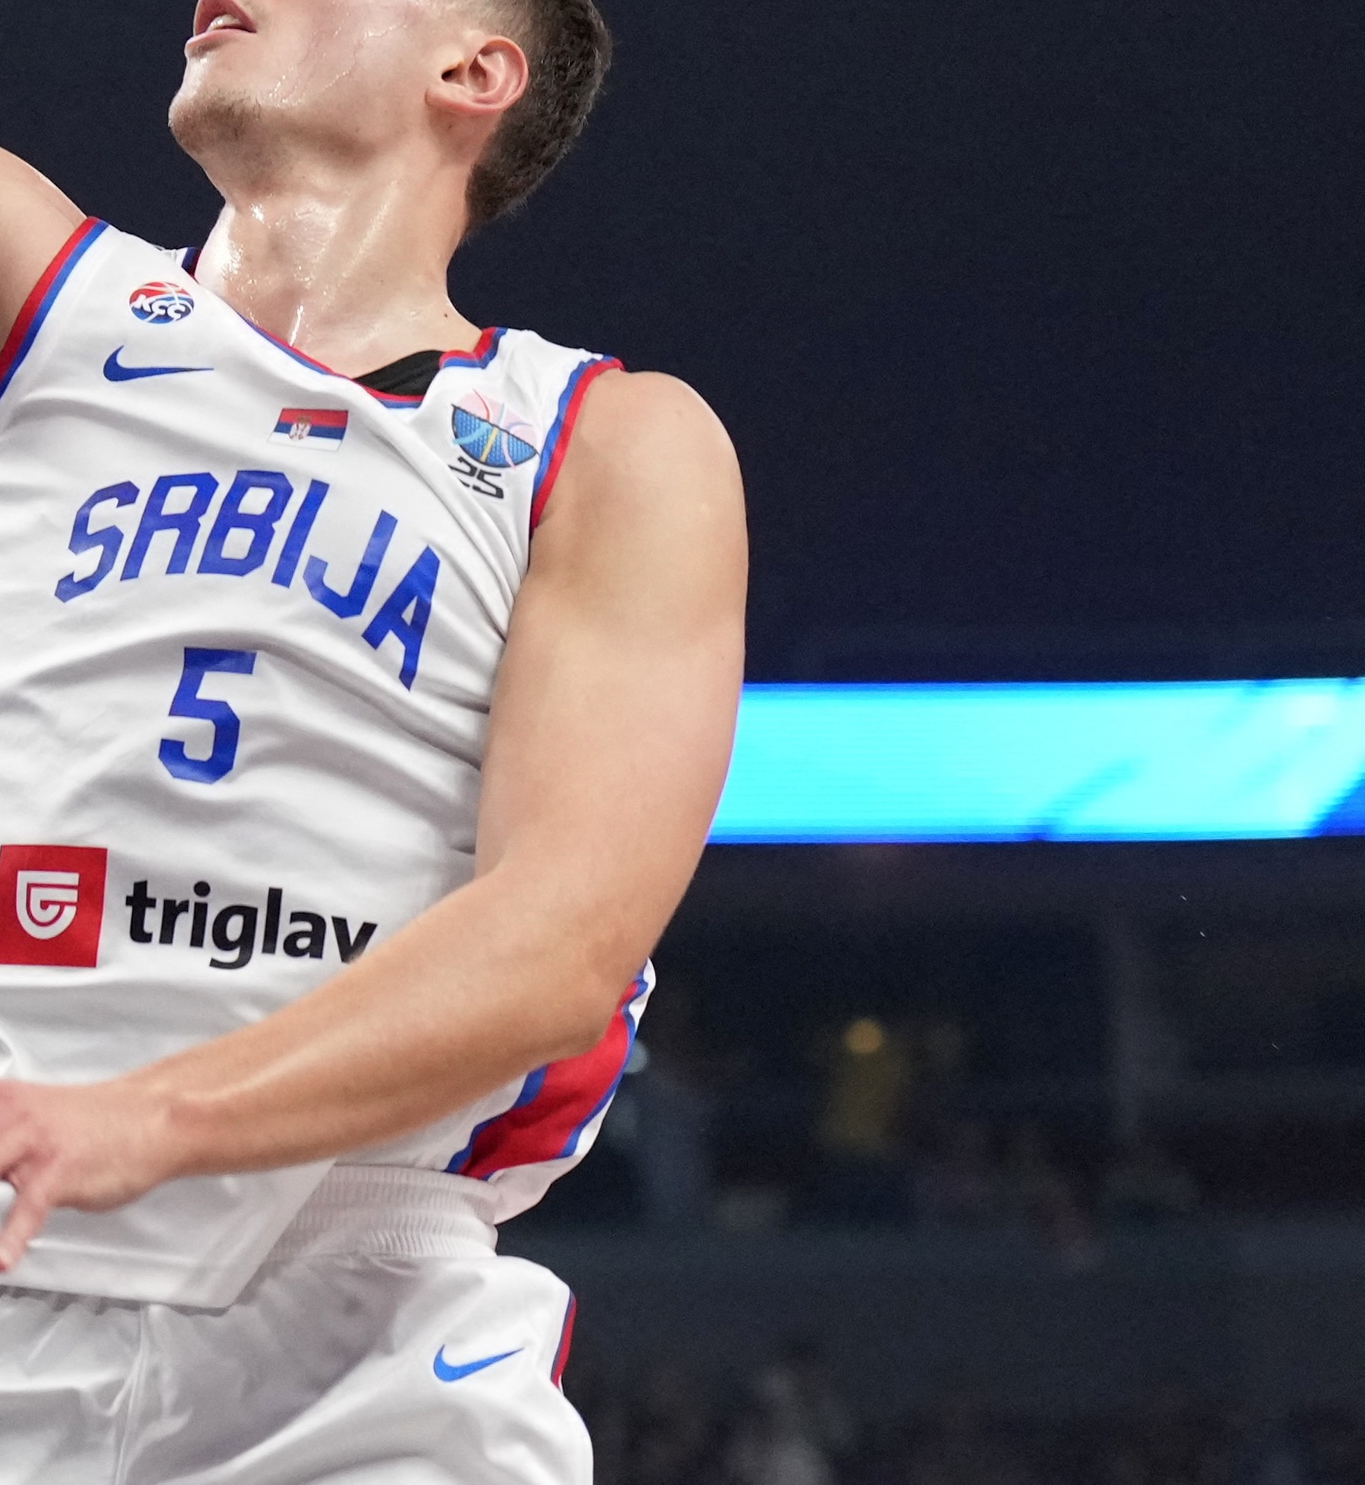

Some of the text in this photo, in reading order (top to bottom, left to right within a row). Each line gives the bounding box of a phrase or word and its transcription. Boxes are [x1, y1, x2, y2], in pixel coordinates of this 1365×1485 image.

[55, 470, 441, 691] SRBIJA
[158, 647, 257, 784] 5
[126, 881, 378, 969] triglav
